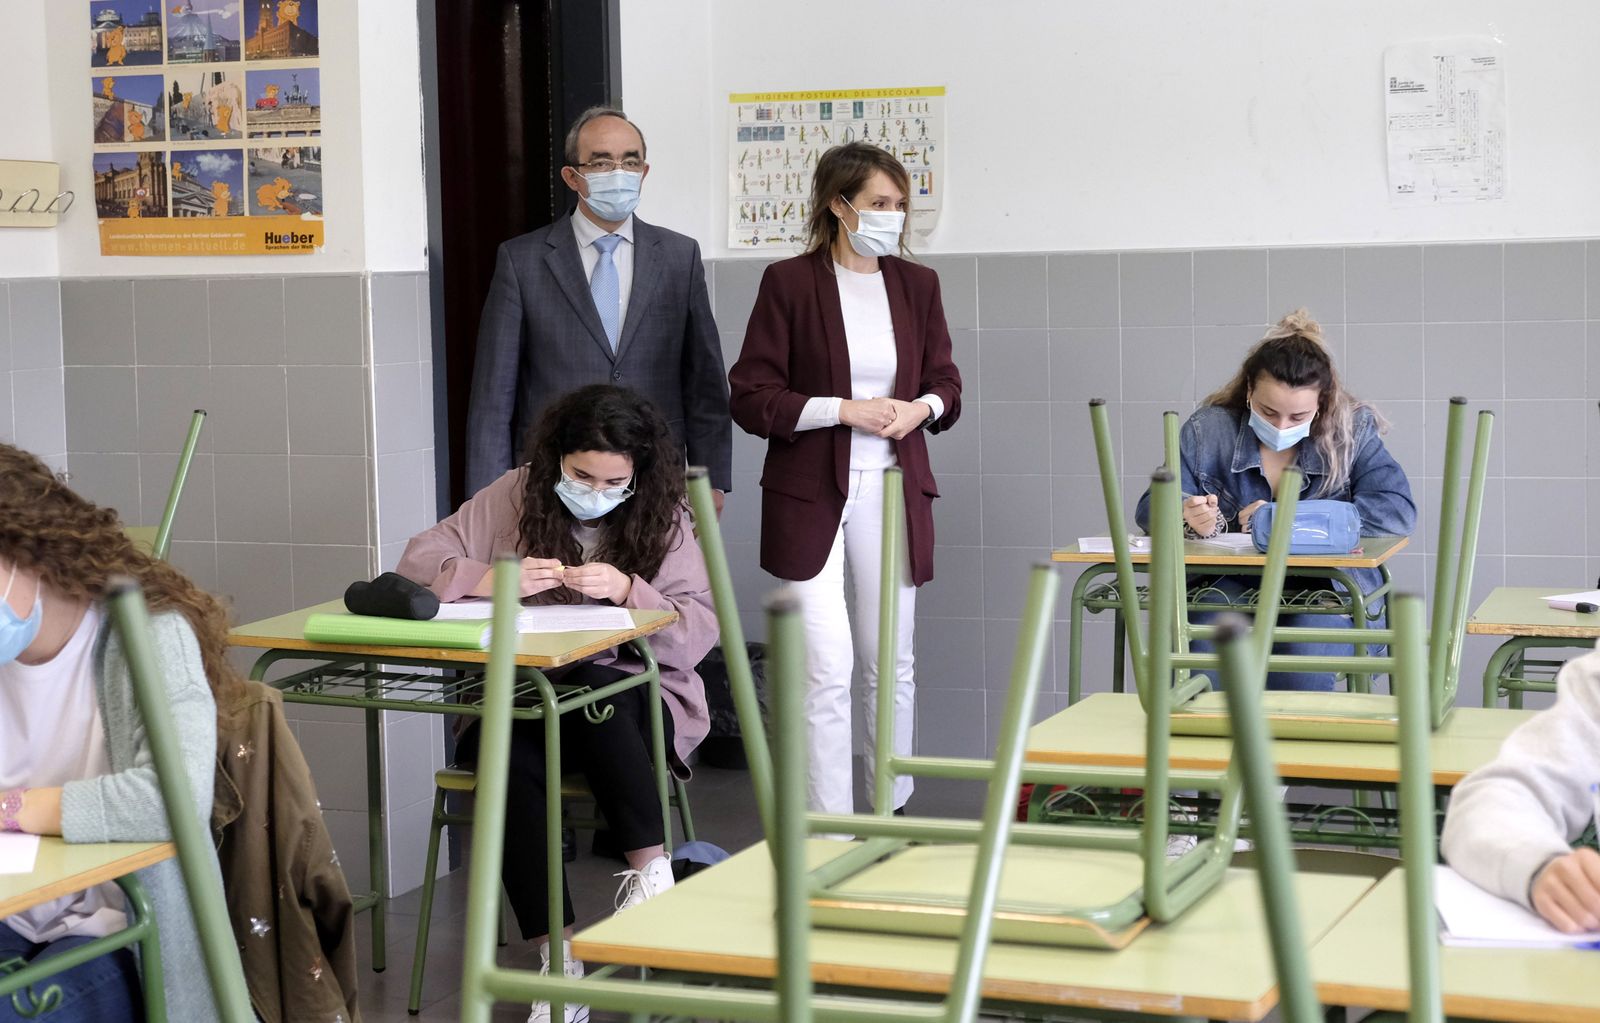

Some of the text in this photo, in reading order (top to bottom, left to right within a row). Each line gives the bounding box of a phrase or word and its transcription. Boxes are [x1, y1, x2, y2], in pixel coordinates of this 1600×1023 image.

[801, 91, 848, 99] POSTURAL
[877, 89, 920, 97] ESCOLAR
[265, 231, 314, 244] Hueber
